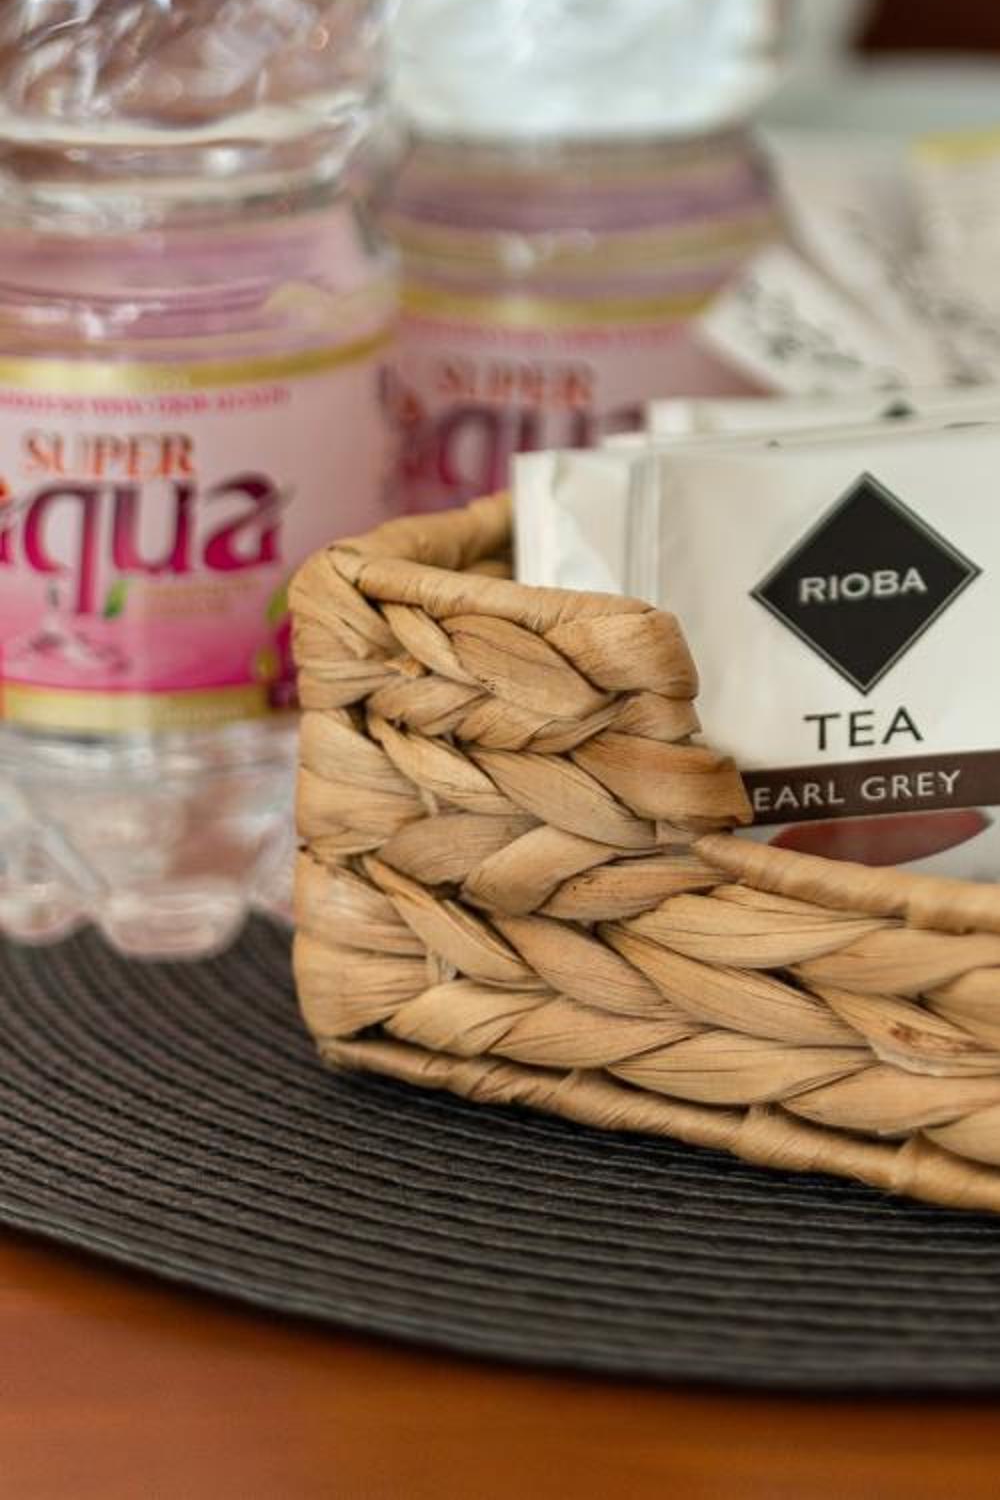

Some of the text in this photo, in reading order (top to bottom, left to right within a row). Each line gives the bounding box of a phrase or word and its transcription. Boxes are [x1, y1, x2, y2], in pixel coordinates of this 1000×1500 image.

[22, 431, 194, 477] SUPER
[0, 474, 286, 615] qua
[799, 567, 927, 603] RIOBA
[803, 706, 923, 750] TEA
[753, 769, 961, 812] EARL GREY
